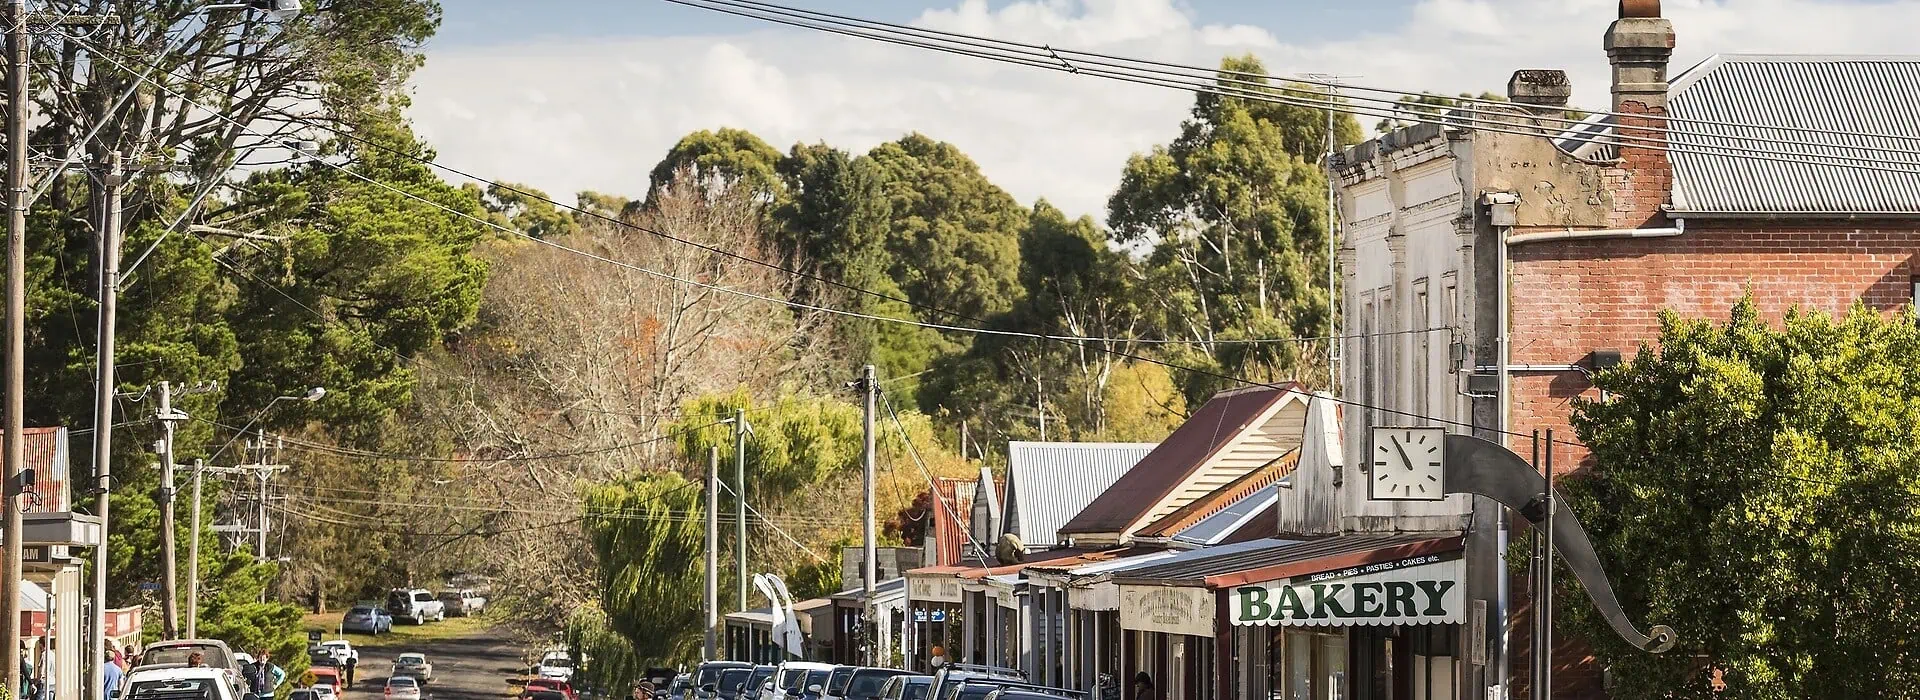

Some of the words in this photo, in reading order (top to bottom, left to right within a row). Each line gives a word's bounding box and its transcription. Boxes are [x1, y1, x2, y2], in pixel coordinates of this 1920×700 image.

[23, 548, 38, 560] AM
[1311, 572, 1335, 582] BREAD
[1343, 568, 1358, 577] PIES
[1366, 562, 1394, 573] PASTIES
[1402, 556, 1426, 567] CAKES
[1237, 580, 1456, 622] BAKERY
